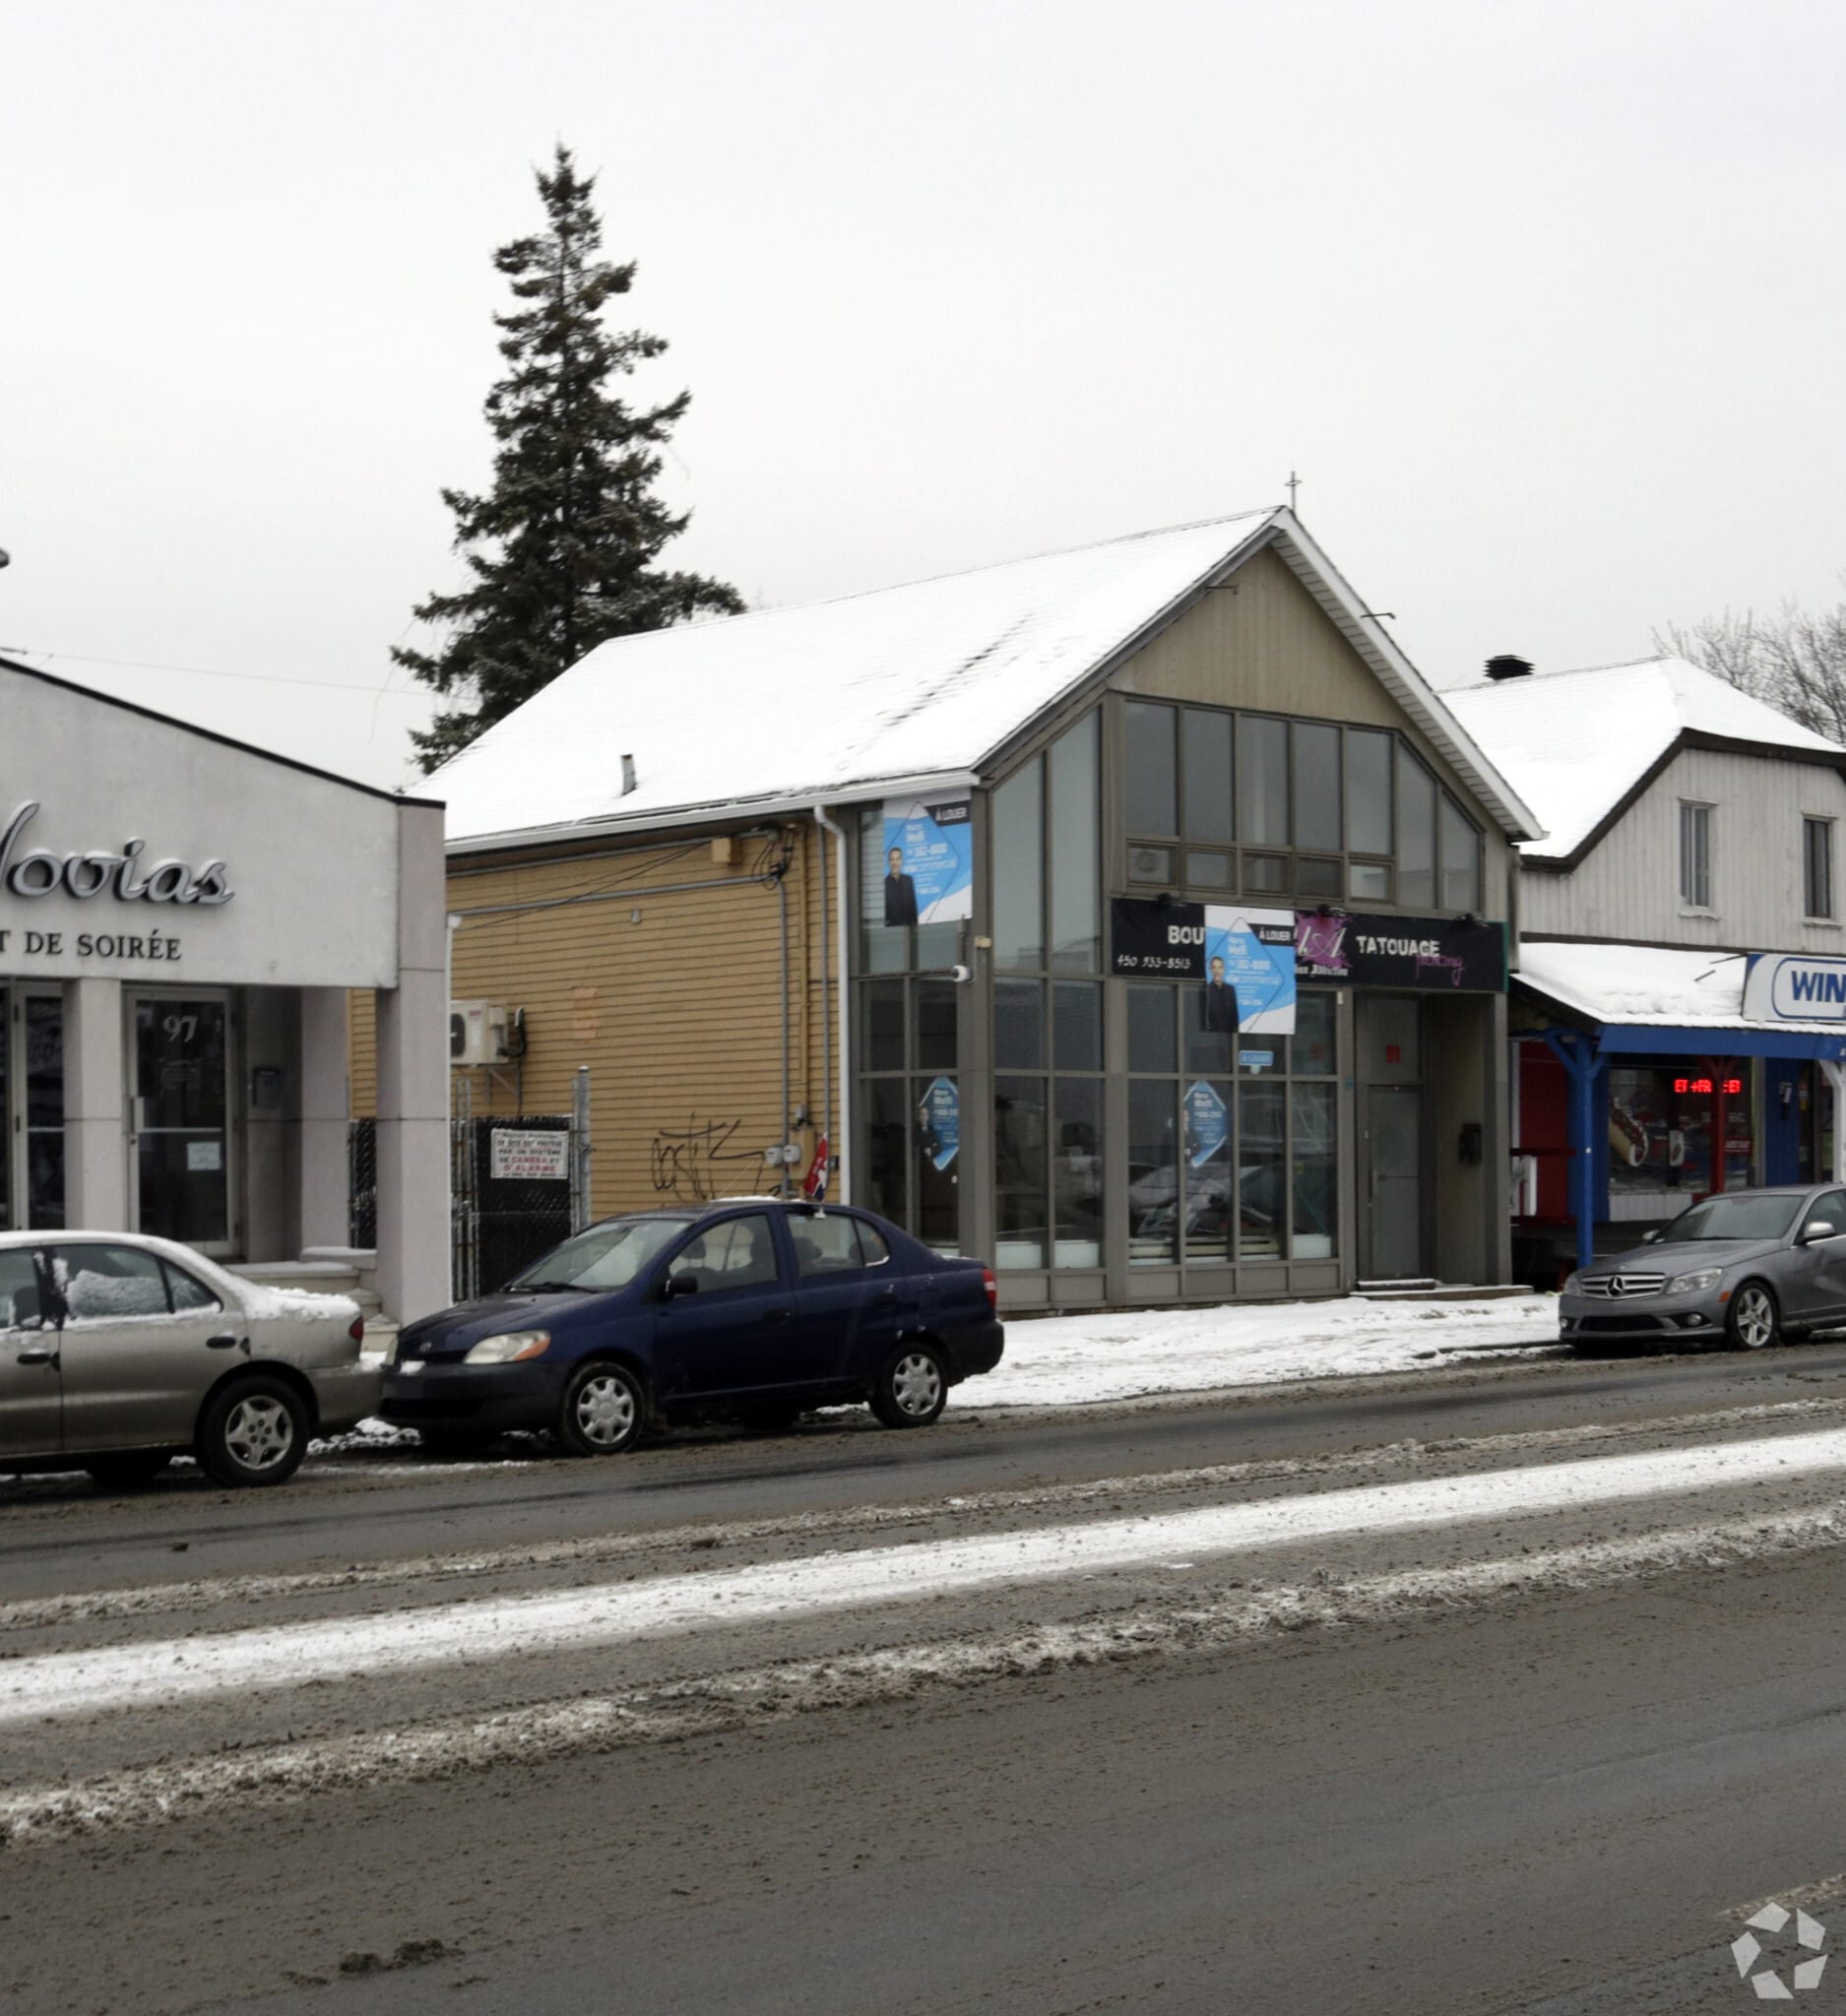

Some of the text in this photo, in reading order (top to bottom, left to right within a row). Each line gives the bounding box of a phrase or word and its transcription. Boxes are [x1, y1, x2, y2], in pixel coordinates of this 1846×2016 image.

[0, 800, 235, 904] ovias
[25, 931, 63, 955] DE
[77, 929, 182, 961] SOIRÉE
[1266, 930, 1292, 941] LOUER
[1356, 935, 1440, 957] TATOUAGE
[1117, 954, 1138, 967] 450
[163, 1015, 197, 1042] 97
